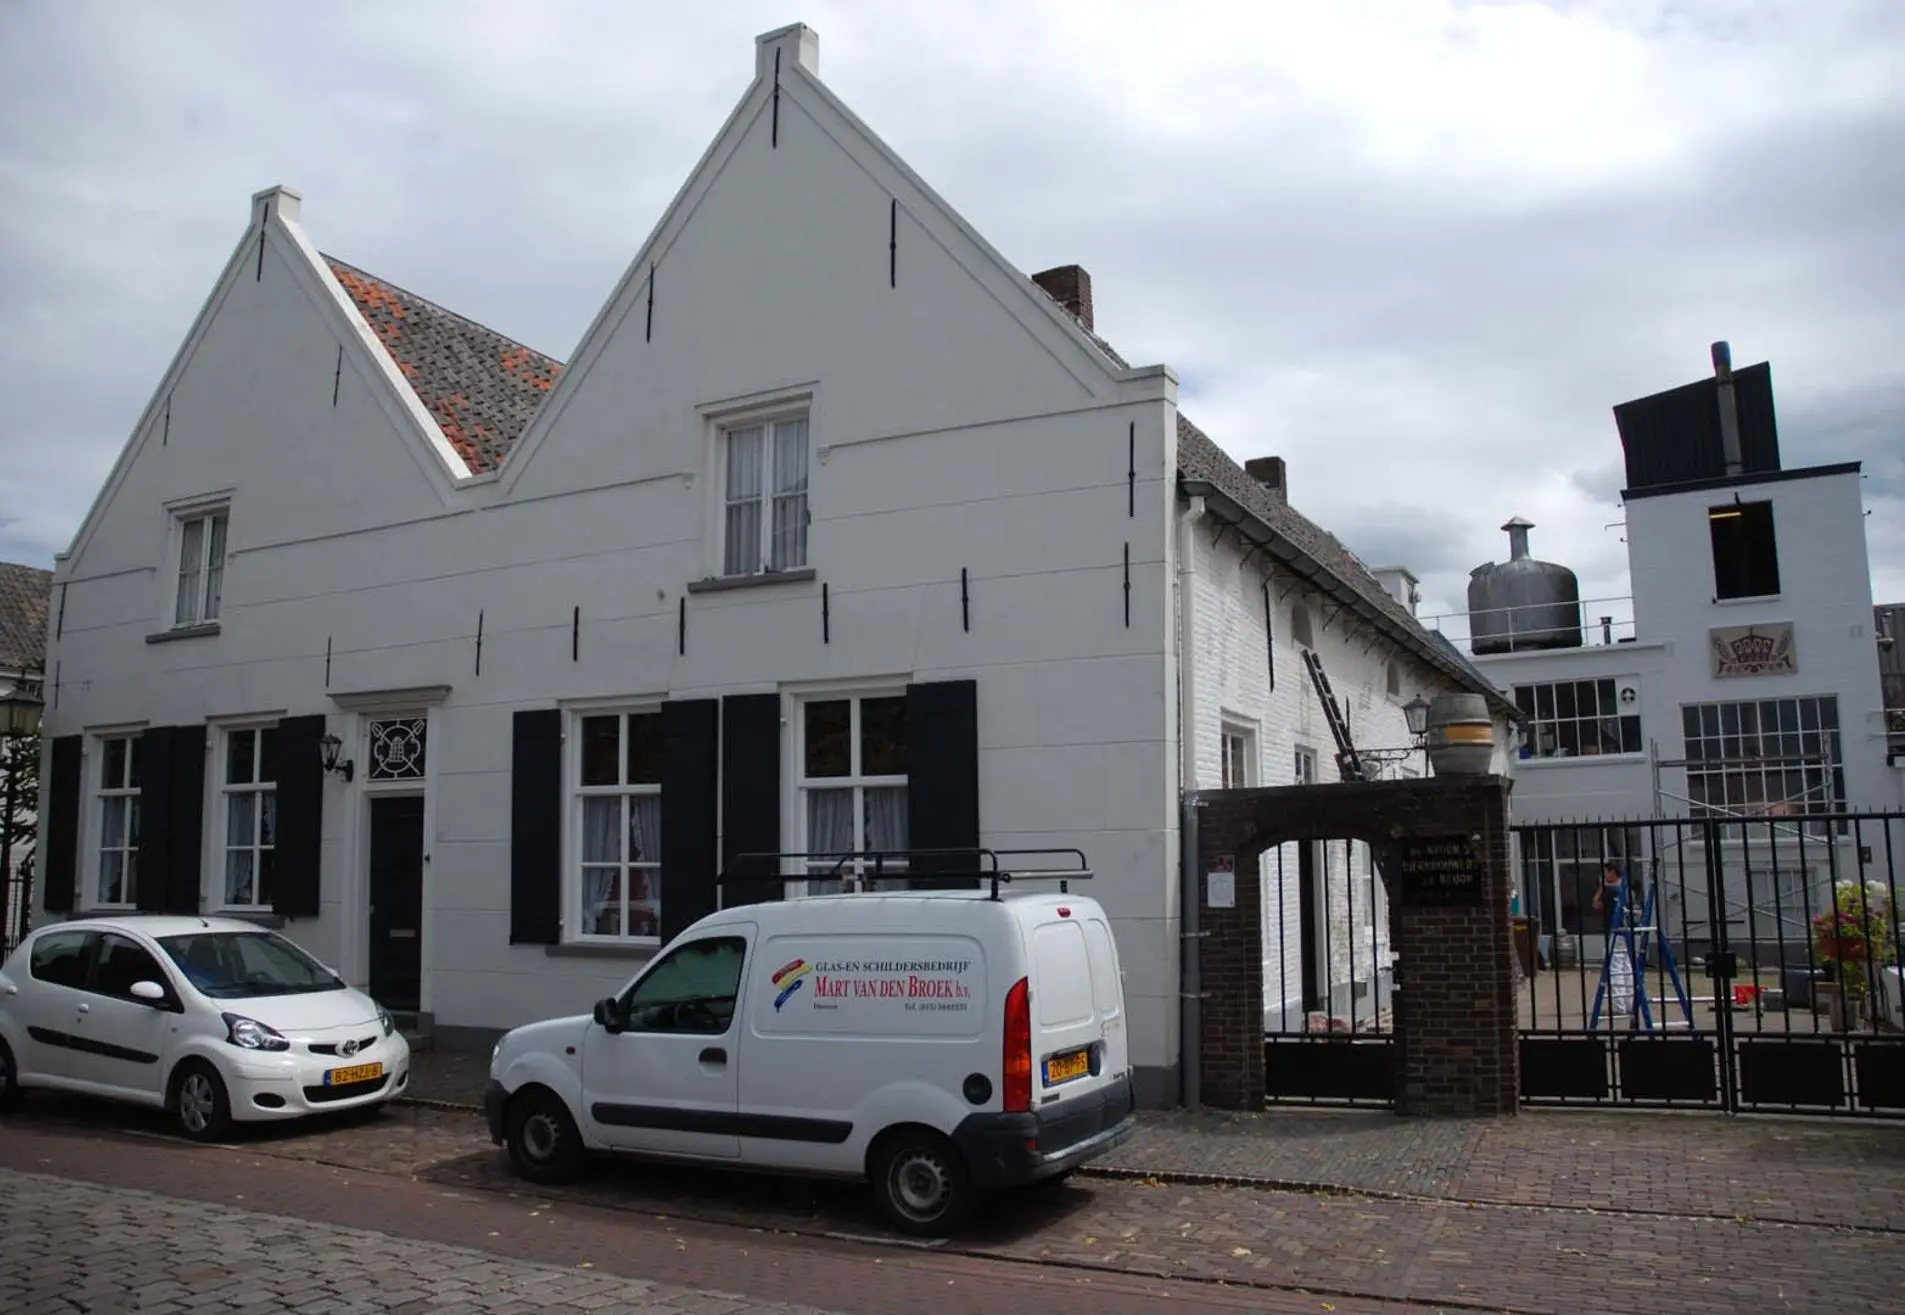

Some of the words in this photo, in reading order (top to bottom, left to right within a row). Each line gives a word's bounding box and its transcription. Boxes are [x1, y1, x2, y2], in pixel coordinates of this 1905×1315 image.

[862, 960, 971, 974] SCHILDERSBEDRIJF
[852, 979, 877, 998] VAN
[879, 979, 905, 998] DEN
